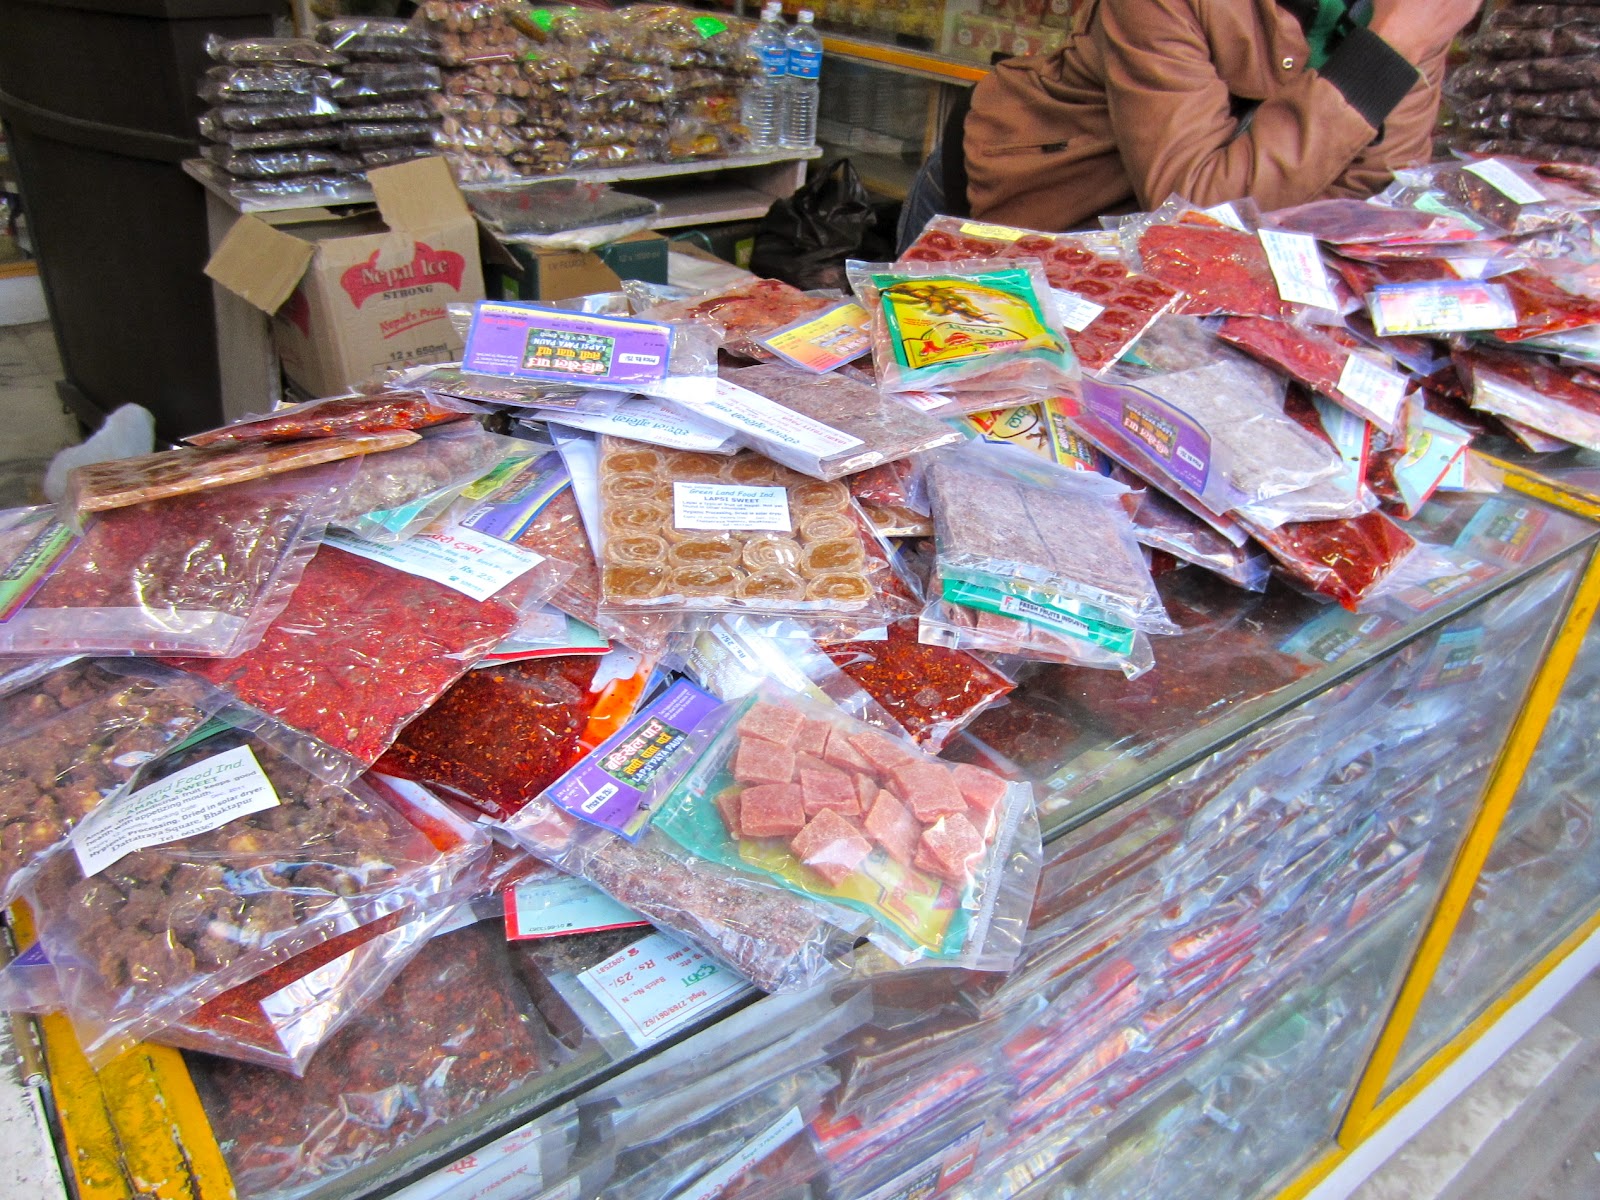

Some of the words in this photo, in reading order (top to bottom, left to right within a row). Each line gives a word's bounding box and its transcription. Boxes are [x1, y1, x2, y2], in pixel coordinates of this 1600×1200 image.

[361, 263, 415, 287] Nepal
[421, 259, 448, 276] Ice
[383, 285, 433, 300] STRONG
[390, 351, 403, 361] 12
[416, 342, 448, 356] 650ml
[533, 338, 556, 346] PAUN
[581, 343, 606, 351] LAPSI
[1019, 601, 1038, 611] FRESH
[1039, 607, 1060, 619] FRUITS
[1060, 616, 1091, 630] INDUSTRY
[632, 761, 654, 782] LAPSI
[650, 750, 669, 764] PATA
[666, 735, 685, 751] PAUN
[137, 783, 172, 806] Land
[176, 768, 212, 791] Food
[216, 759, 244, 773] Ind.
[182, 784, 201, 797] fruit
[204, 779, 231, 793] keeps
[233, 770, 257, 781] good
[126, 794, 170, 815] AMALA
[174, 774, 217, 799] SWEET
[585, 799, 600, 810] Price
[134, 801, 181, 824] appetizing
[182, 789, 214, 806] mouth.
[203, 793, 252, 821] Bhaktapur
[89, 836, 129, 858] Hygienic
[181, 807, 206, 821] Dried
[217, 795, 238, 806] solar
[240, 786, 265, 798] dryer.
[634, 958, 655, 970] Rs.
[609, 971, 634, 988] 25/-
[644, 974, 666, 990] Batch
[686, 987, 707, 1002] Regd.
